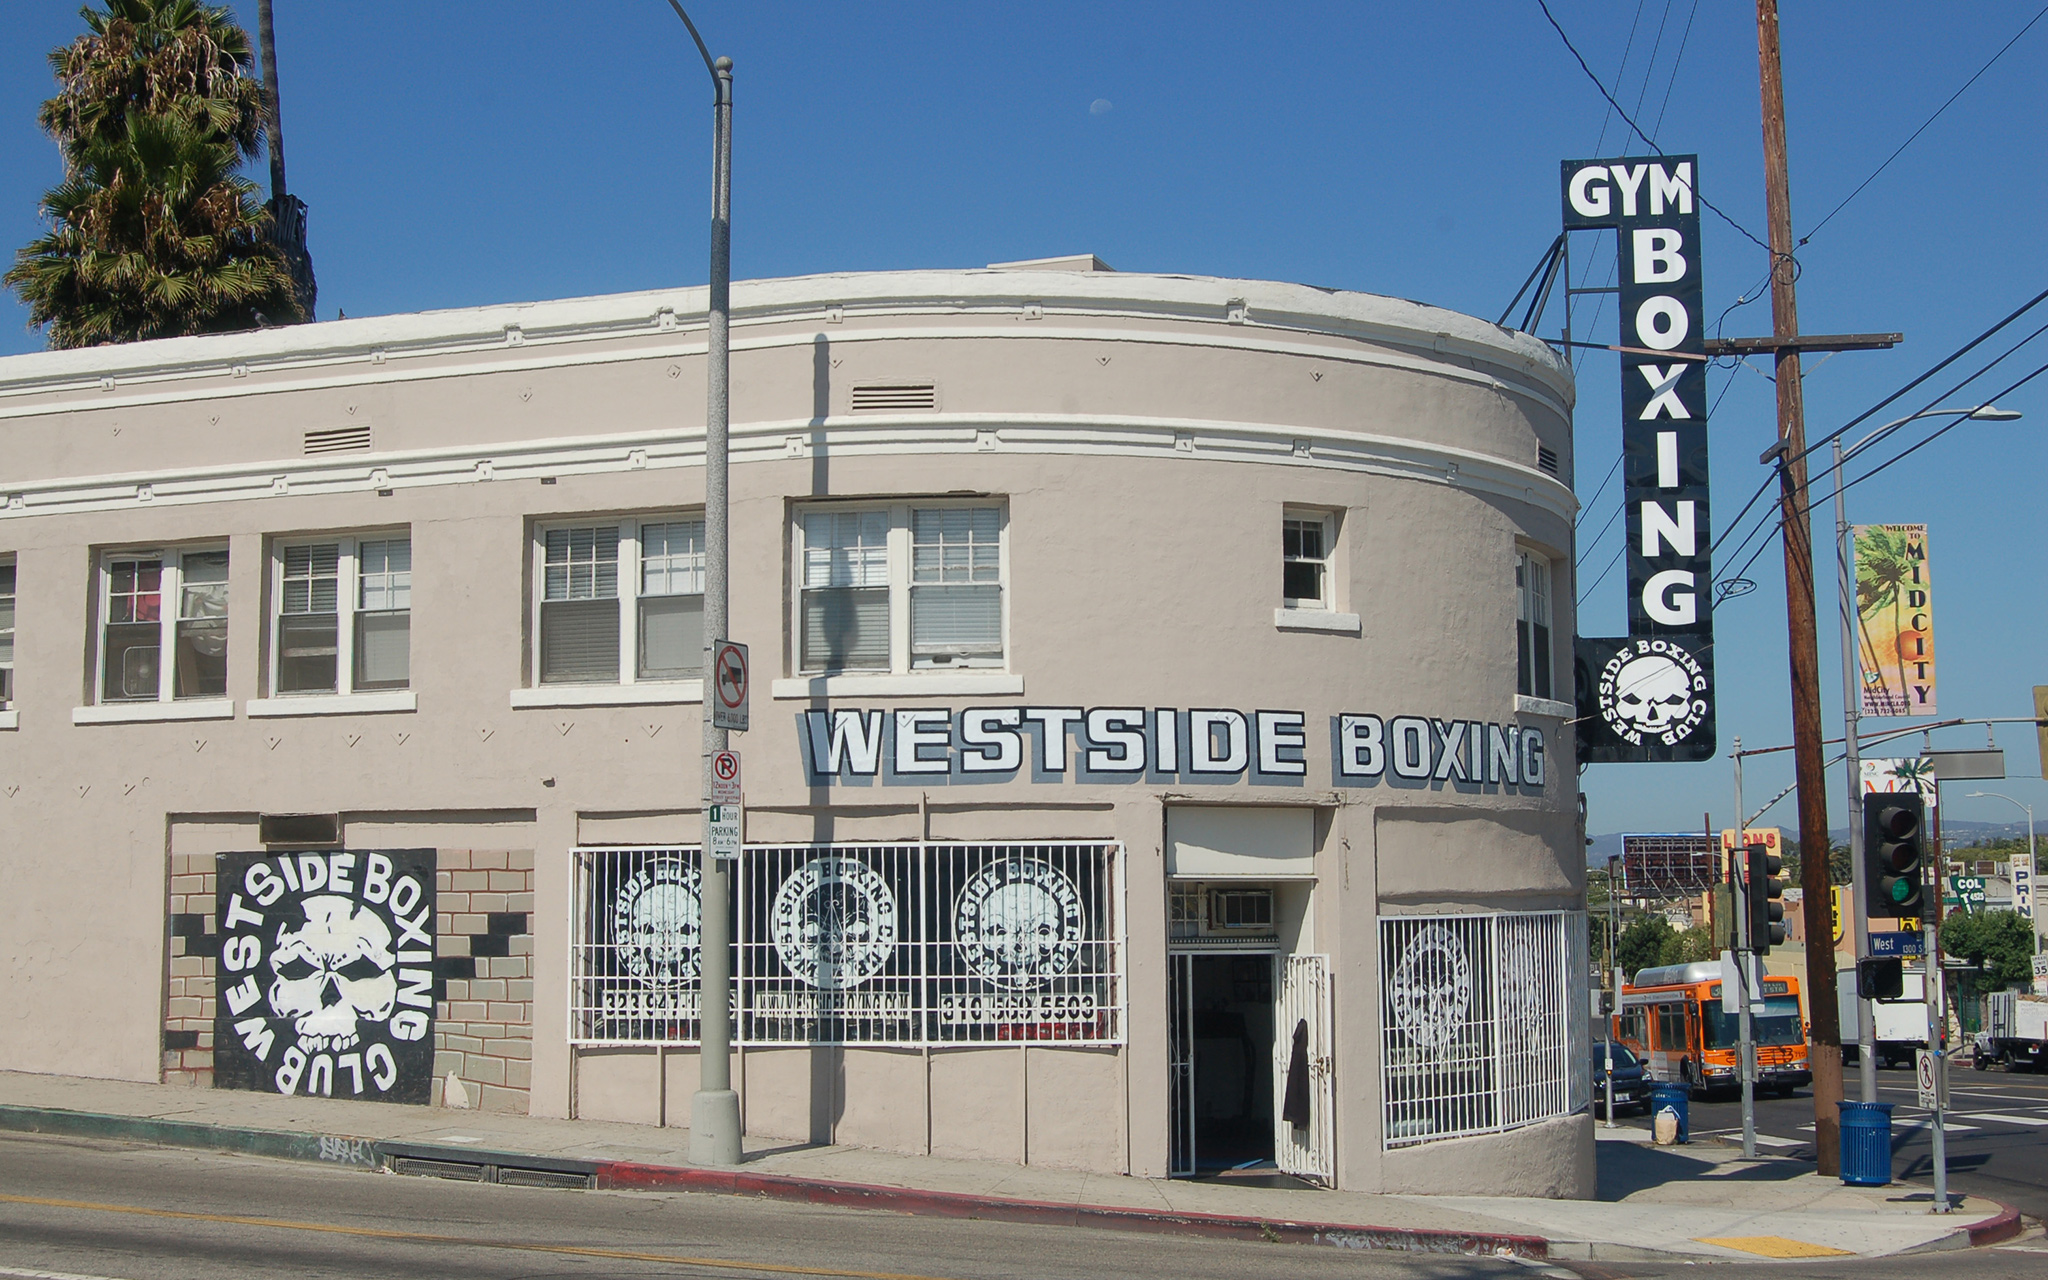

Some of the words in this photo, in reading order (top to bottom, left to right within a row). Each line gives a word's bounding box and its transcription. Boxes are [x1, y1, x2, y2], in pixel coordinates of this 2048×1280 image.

[1568, 161, 1693, 218] GYM
[1632, 227, 1697, 626] BOXING
[1886, 524, 1925, 533] WELCOME
[1909, 532, 1921, 540] TO
[1637, 639, 1708, 692] BOXING
[1599, 647, 1642, 747] WESTSIDE
[1663, 699, 1708, 747] CLUB
[804, 706, 1307, 778] WESTSIDE
[1338, 711, 1544, 786] BOXING
[711, 826, 738, 837] PARKING
[722, 811, 738, 821] HOUR
[821, 861, 894, 916] BOXING
[1008, 863, 1080, 919] BOXING
[1957, 878, 1982, 889] COL
[223, 851, 356, 1063] WESTSIDE
[362, 852, 433, 1042] BOXING
[1873, 937, 1894, 950] West
[1902, 944, 1916, 954] 1300
[1918, 944, 1923, 953] S
[2034, 965, 2047, 975] 35
[274, 1042, 398, 1097] CLUB
